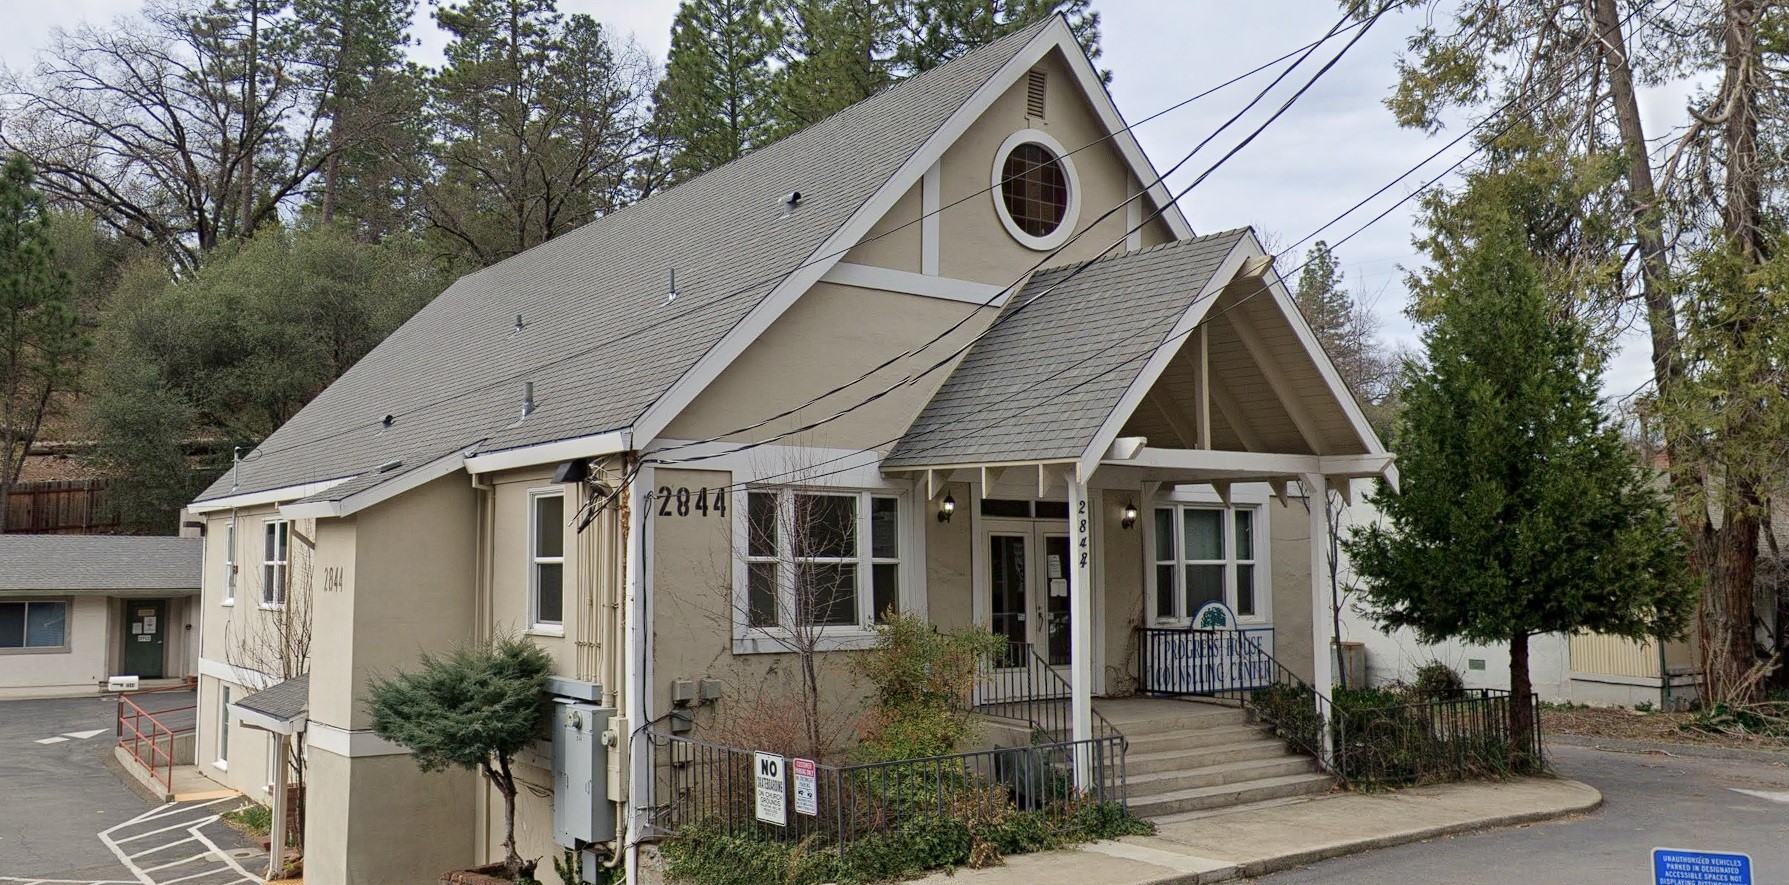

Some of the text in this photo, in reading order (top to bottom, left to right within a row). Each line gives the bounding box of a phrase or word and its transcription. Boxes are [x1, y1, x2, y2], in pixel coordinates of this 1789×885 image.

[658, 485, 726, 517] 2844
[1078, 500, 1088, 568] 2844
[324, 566, 343, 592] 2844
[1165, 636, 1262, 660] PROGRESS HOUSE
[1231, 660, 1271, 681] CENTER
[761, 758, 777, 777] NO
[760, 796, 781, 807] GROUNDS
[1662, 855, 1742, 867] UNAUTHORIZED VEHICLES
[1666, 863, 1691, 872] PARKED
[1701, 865, 1740, 874] DESIGNATED
[1665, 871, 1703, 880] ACCESSIBLE
[1704, 873, 1728, 881] SPACES
